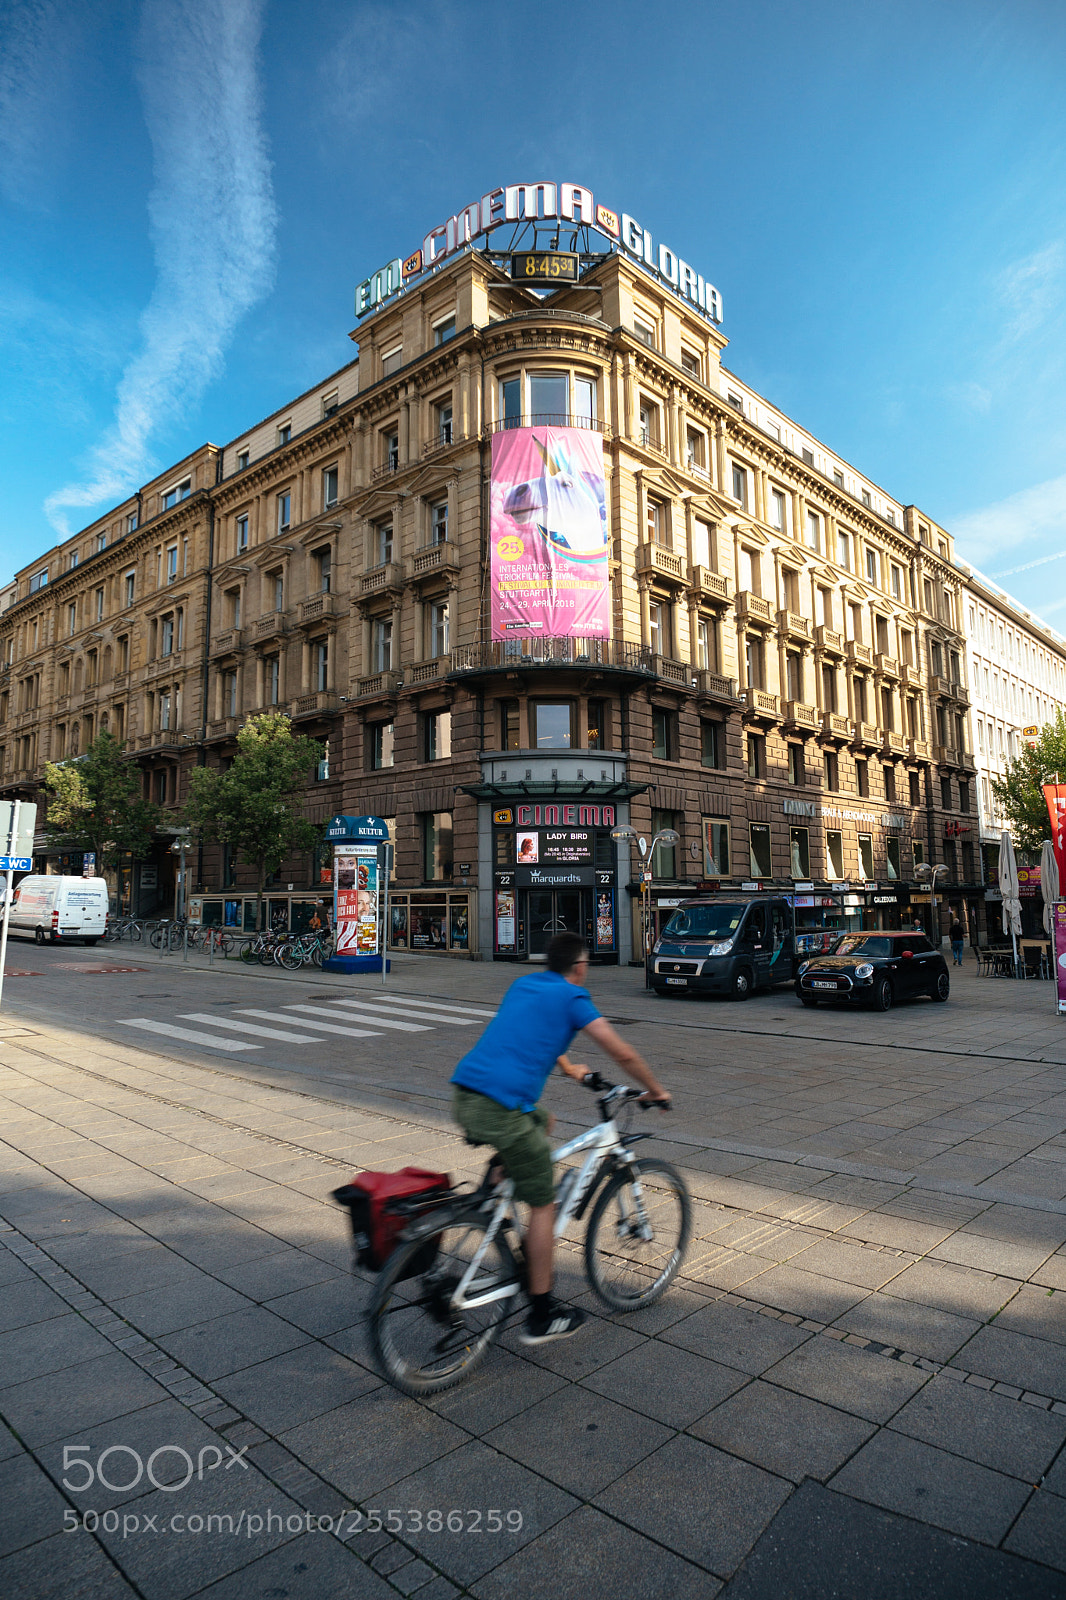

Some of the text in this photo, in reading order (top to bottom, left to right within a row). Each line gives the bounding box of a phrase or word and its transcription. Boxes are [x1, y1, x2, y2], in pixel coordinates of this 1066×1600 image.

[355, 180, 724, 325] EM CINEMA GLORIA
[499, 563, 569, 573] INTERNATIONLES
[499, 572, 539, 582] TRICKFILM
[499, 589, 545, 599] STUTTGART
[555, 599, 575, 608] 2018
[517, 804, 615, 827] CINEMA
[358, 827, 383, 836] KULTUR
[546, 833, 588, 841] LADY BIRD
[8, 859, 27, 869] WC
[500, 875, 510, 885] 22
[531, 873, 582, 885] marquardts
[600, 874, 610, 884] 22
